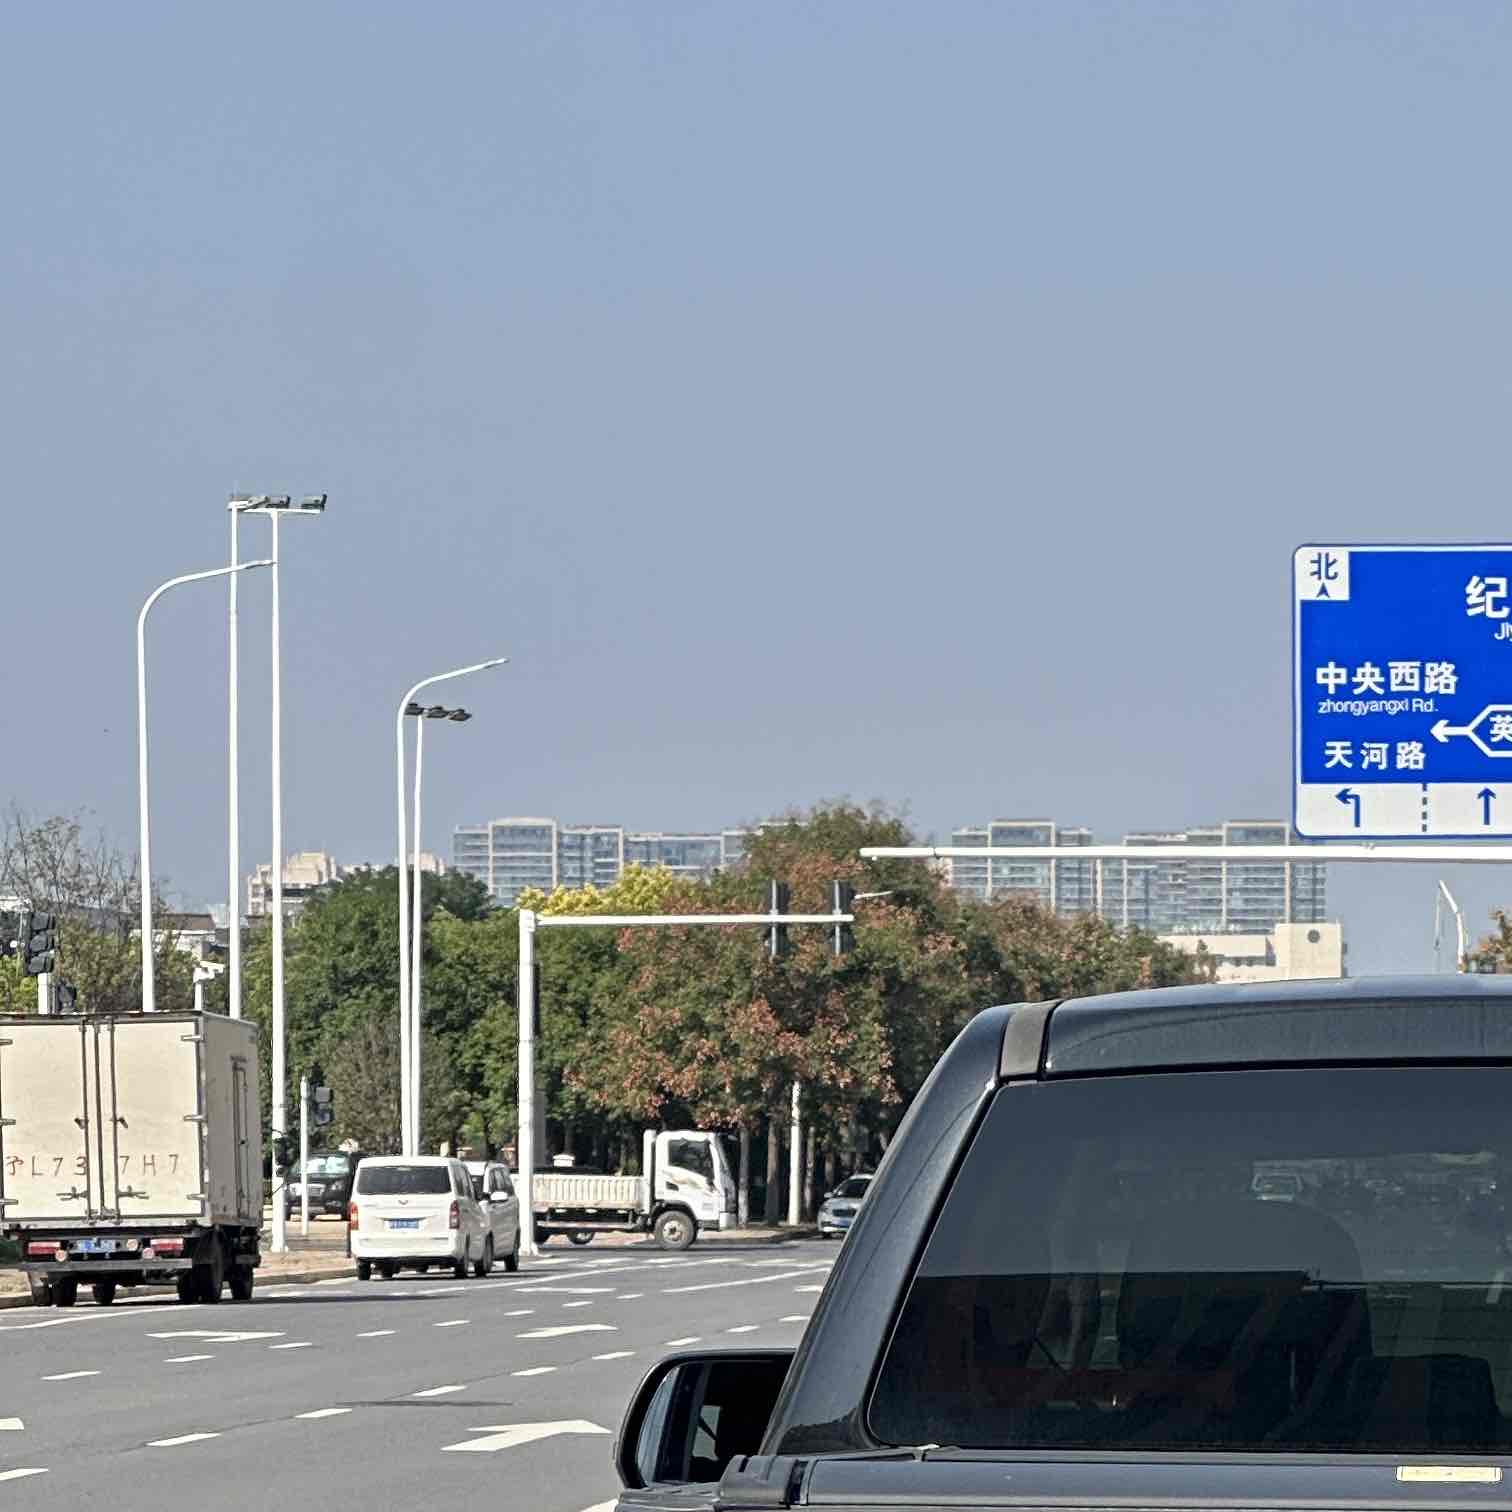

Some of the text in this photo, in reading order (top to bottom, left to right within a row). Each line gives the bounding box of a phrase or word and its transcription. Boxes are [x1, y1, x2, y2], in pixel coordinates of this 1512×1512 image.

[1309, 552, 1338, 580] 北
[1316, 661, 1458, 695] 中央西路
[1318, 698, 1440, 716] zhongyangxi Rd.
[1324, 741, 1425, 770] 天河路
